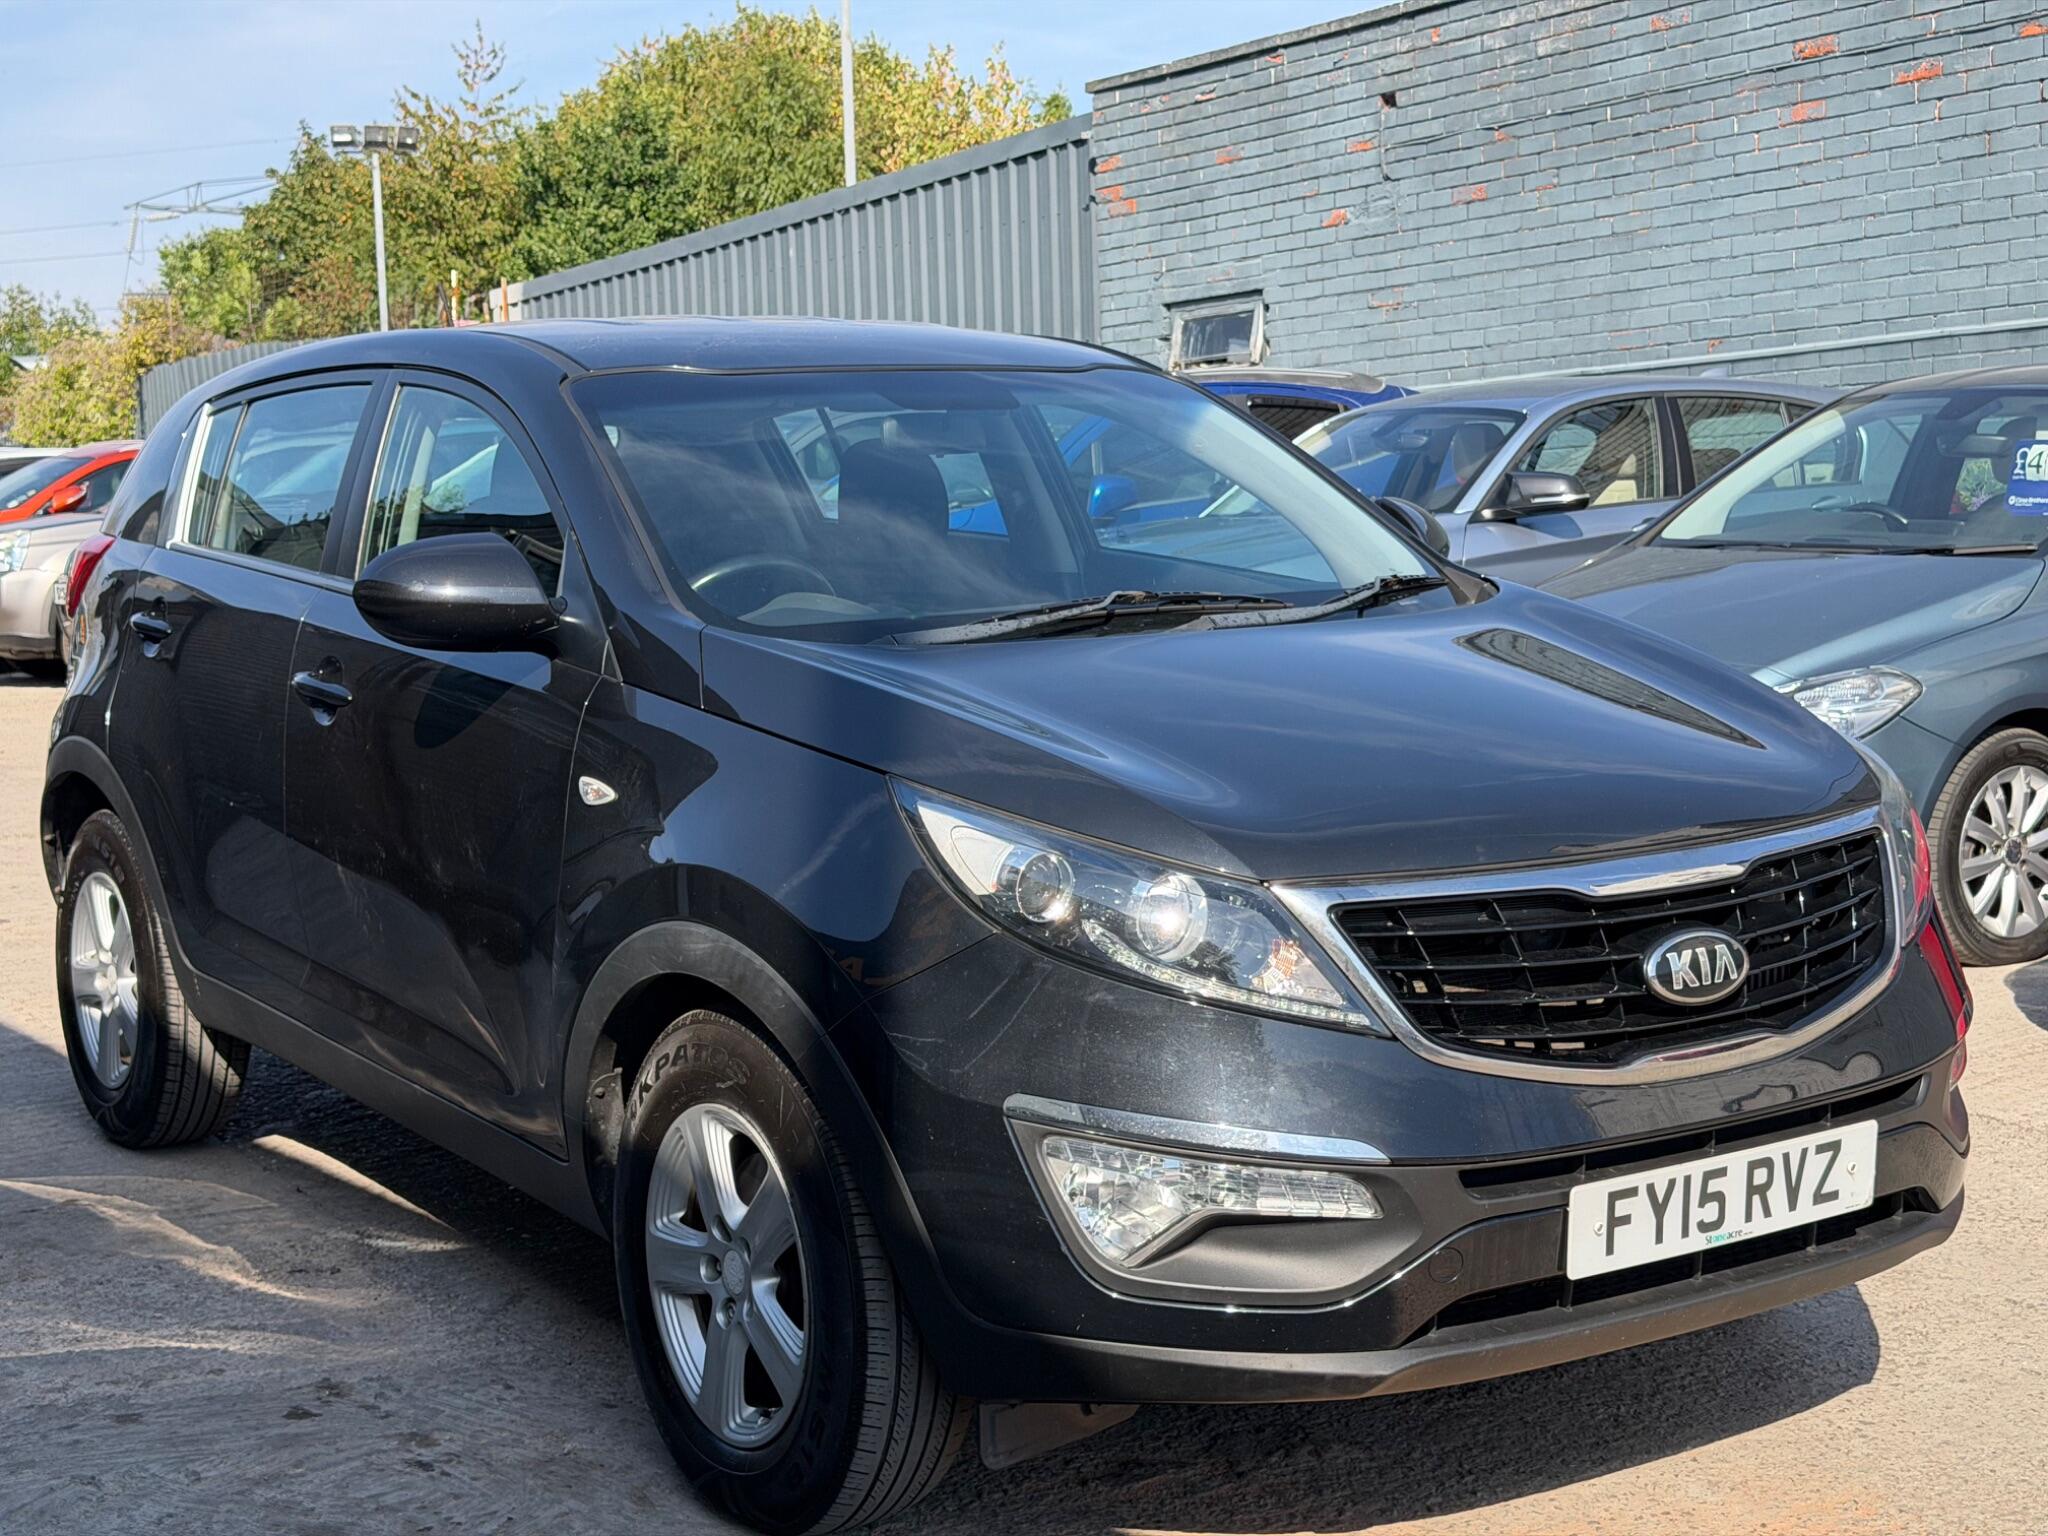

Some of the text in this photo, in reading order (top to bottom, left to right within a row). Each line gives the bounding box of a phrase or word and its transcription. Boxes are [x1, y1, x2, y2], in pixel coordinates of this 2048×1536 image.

[1666, 943, 1738, 990] KIA
[1605, 1138, 1842, 1256] FY15 RVZ
